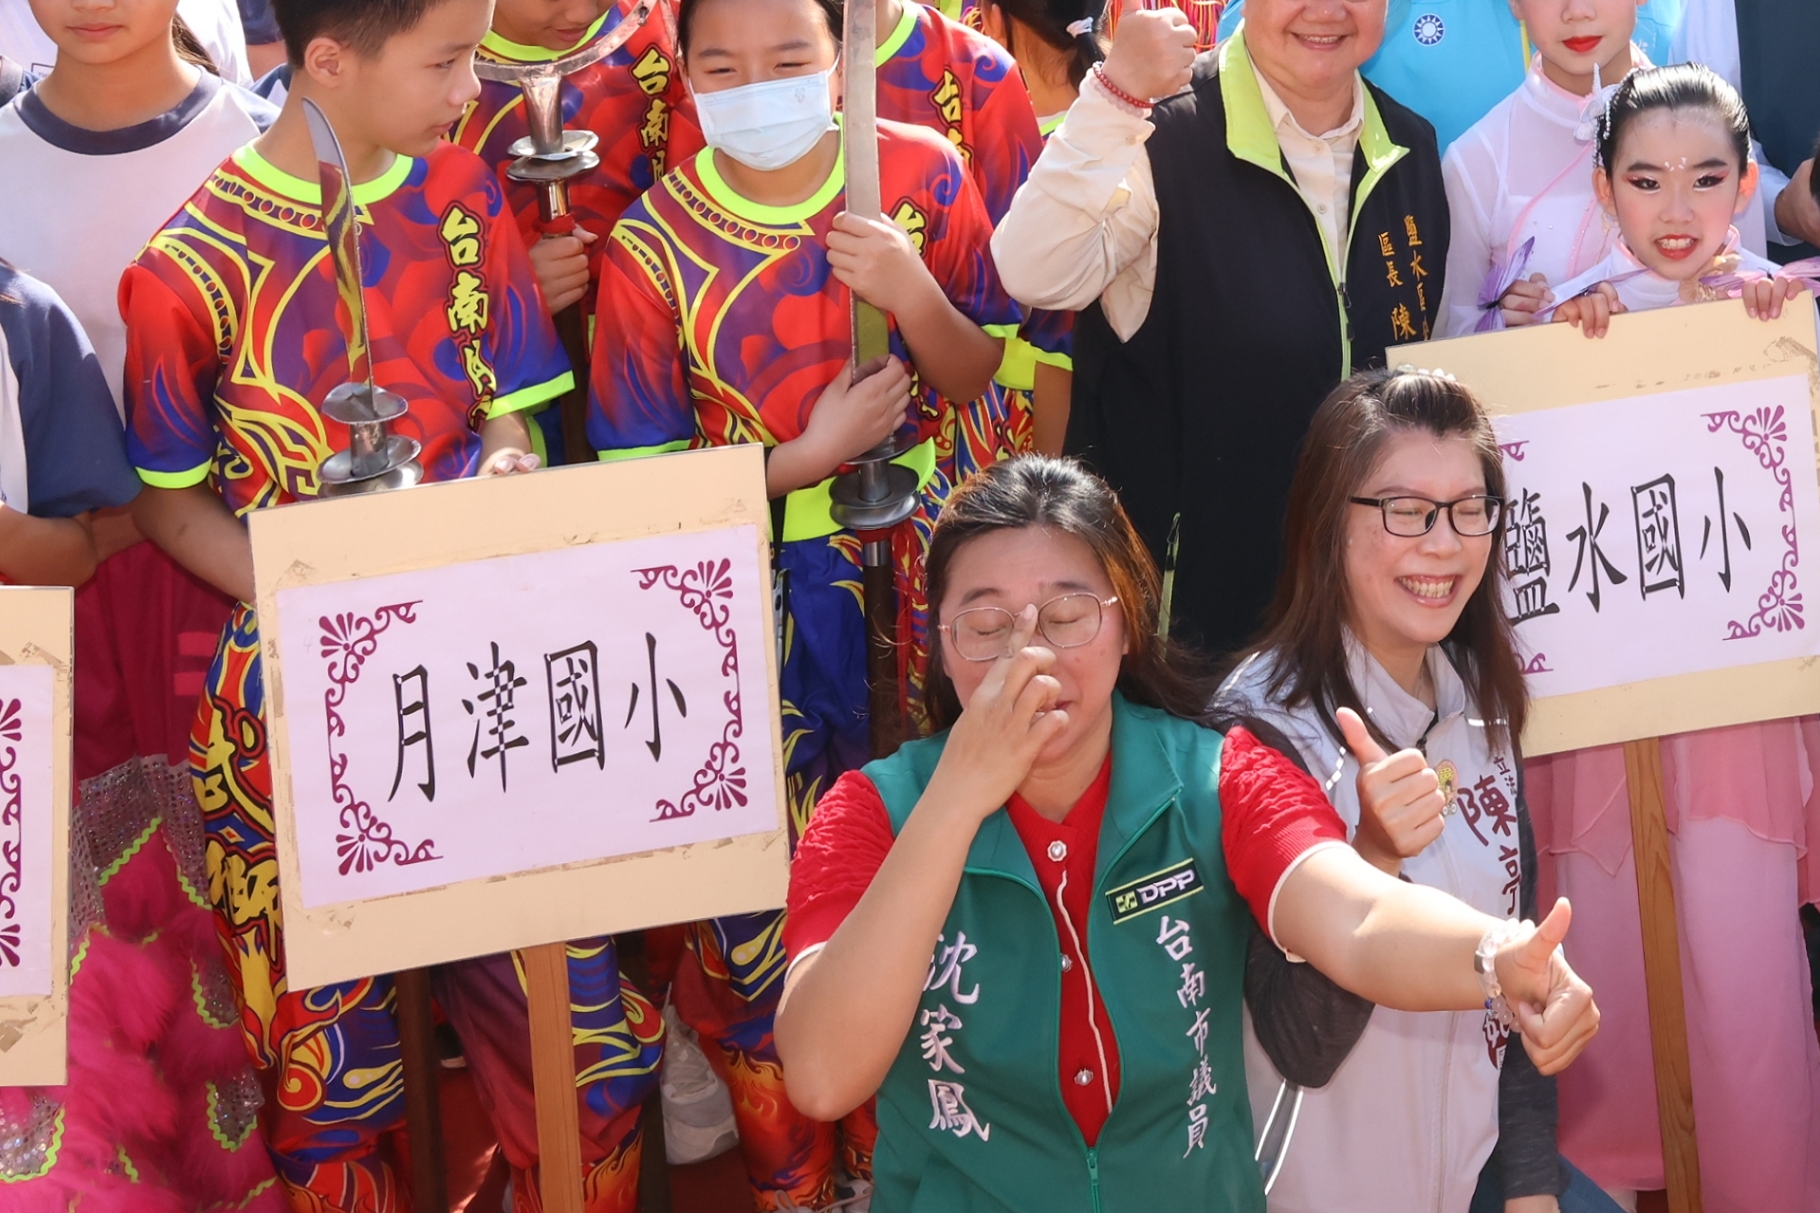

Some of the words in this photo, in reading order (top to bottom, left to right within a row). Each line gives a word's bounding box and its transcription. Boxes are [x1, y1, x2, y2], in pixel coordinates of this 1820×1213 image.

[1391, 302, 1417, 341] 陳
[1504, 466, 1752, 626] 鹽水國小
[387, 631, 687, 803] 月津國小
[1137, 868, 1198, 907] DPP
[922, 929, 992, 1143] 沈家鳳
[1154, 916, 1218, 1160] 台南市議員
